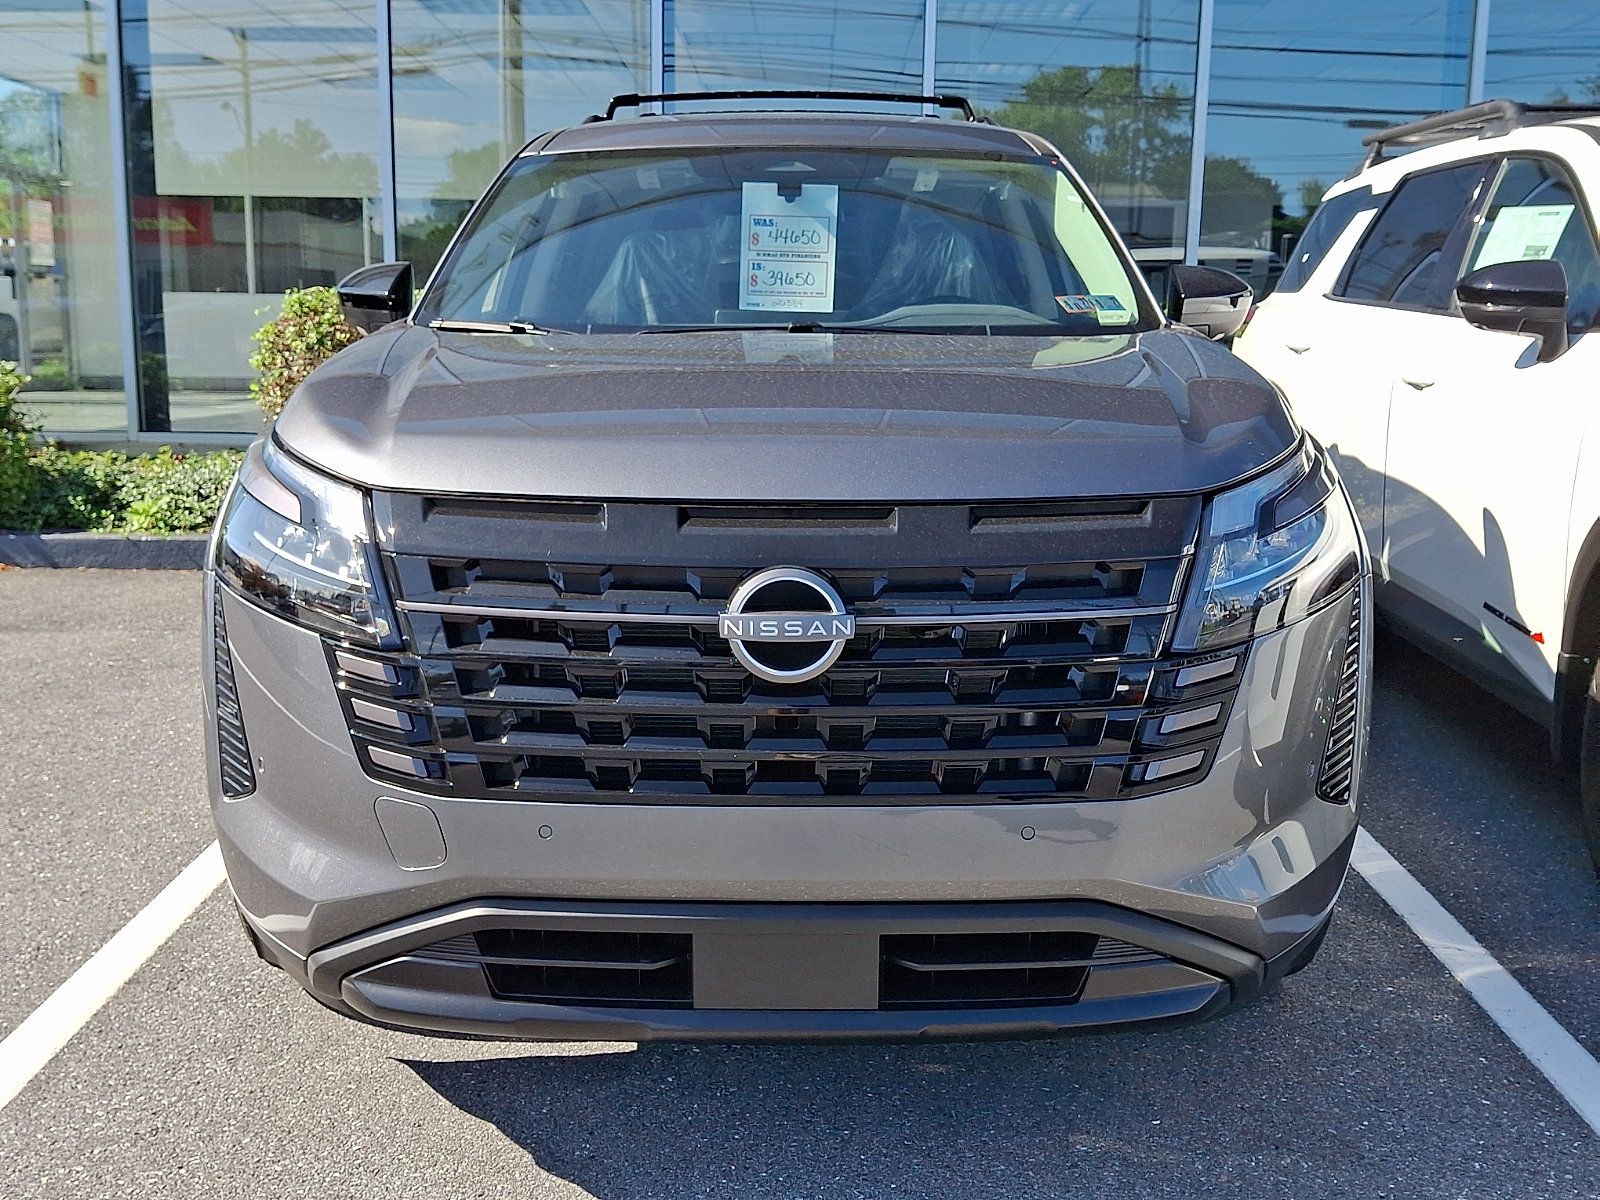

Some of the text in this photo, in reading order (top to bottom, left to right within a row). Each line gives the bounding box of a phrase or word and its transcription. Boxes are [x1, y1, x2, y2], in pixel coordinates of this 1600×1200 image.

[752, 218, 778, 228] WAS:
[768, 228, 821, 245] 44650
[751, 262, 766, 272] IS:
[762, 270, 816, 287] 39650
[723, 619, 851, 637] NISSAN
